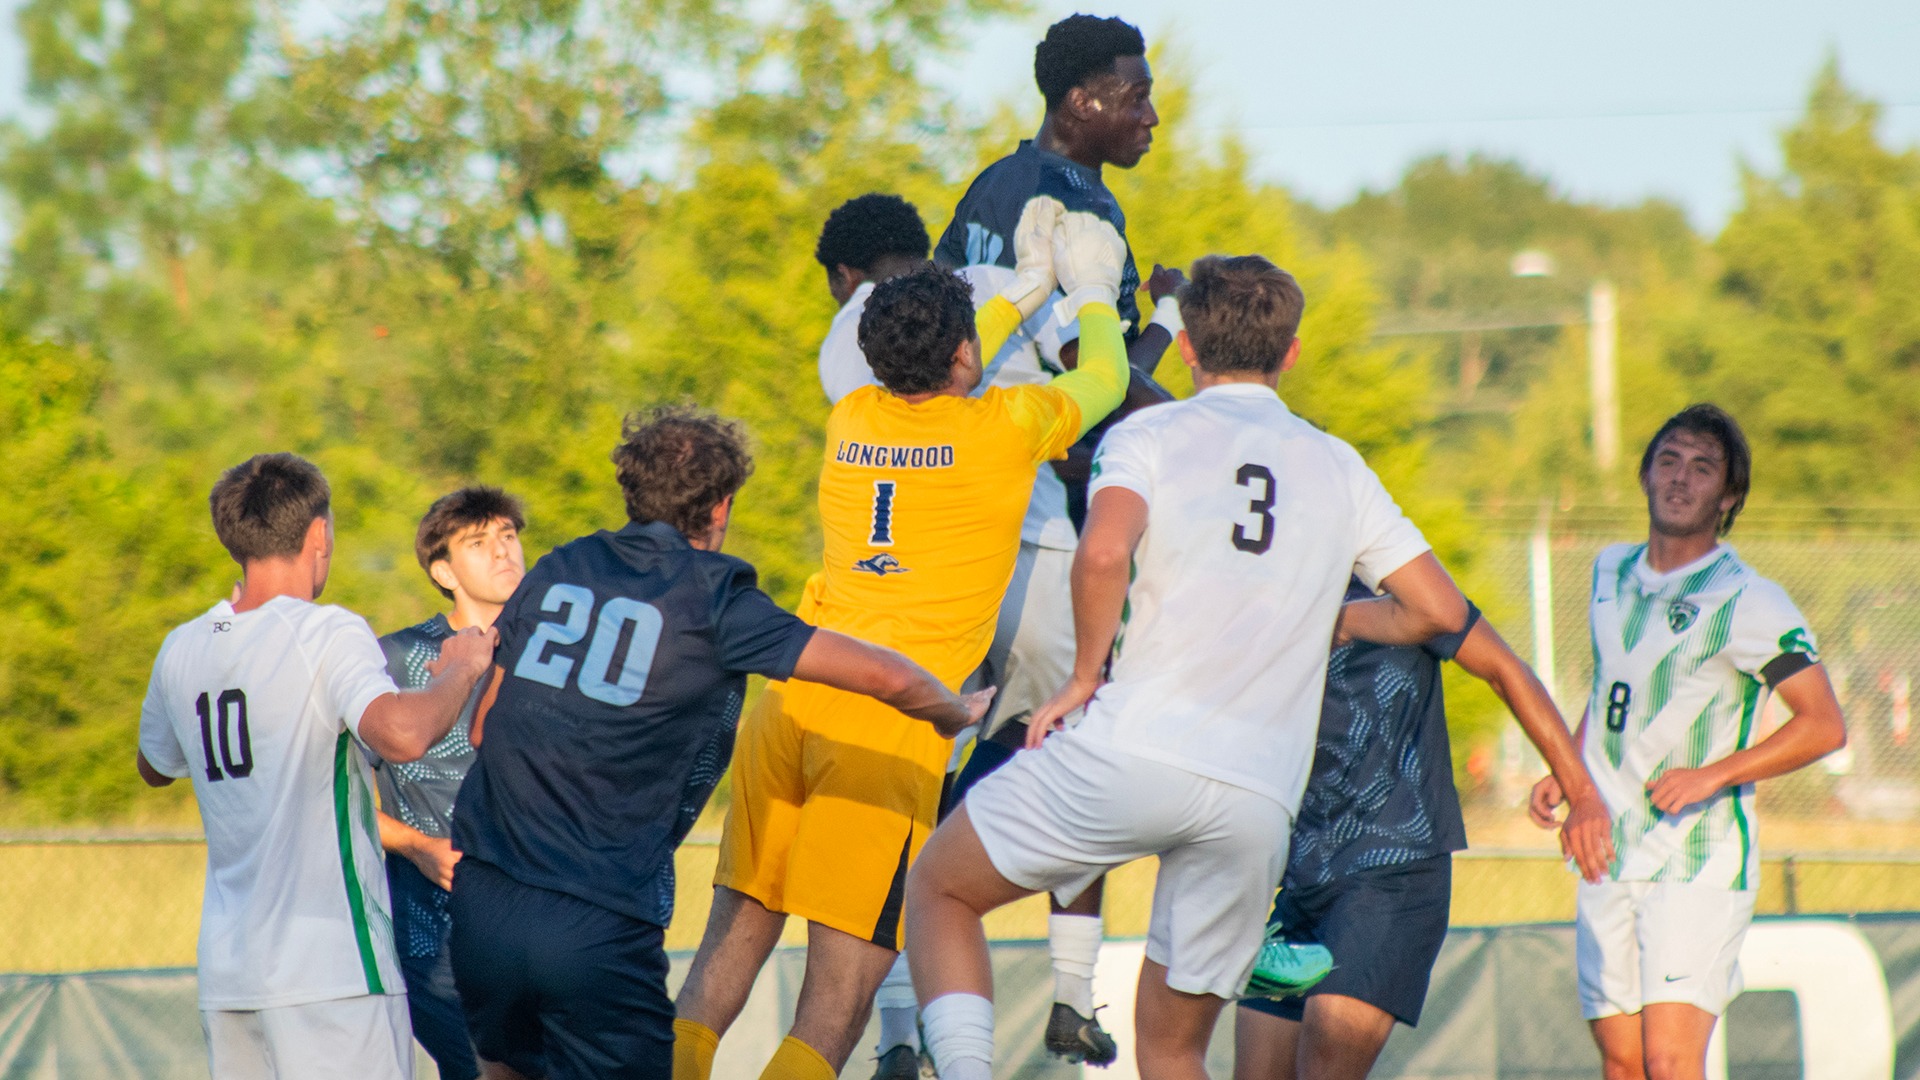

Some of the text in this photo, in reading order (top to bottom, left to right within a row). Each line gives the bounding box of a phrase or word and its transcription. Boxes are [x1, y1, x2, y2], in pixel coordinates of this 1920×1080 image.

[836, 440, 955, 470] LONGWOOD
[868, 480, 896, 547] 1
[1231, 462, 1276, 556] 3
[513, 582, 664, 708] 20
[195, 688, 254, 783] 10
[1606, 681, 1632, 734] 8
